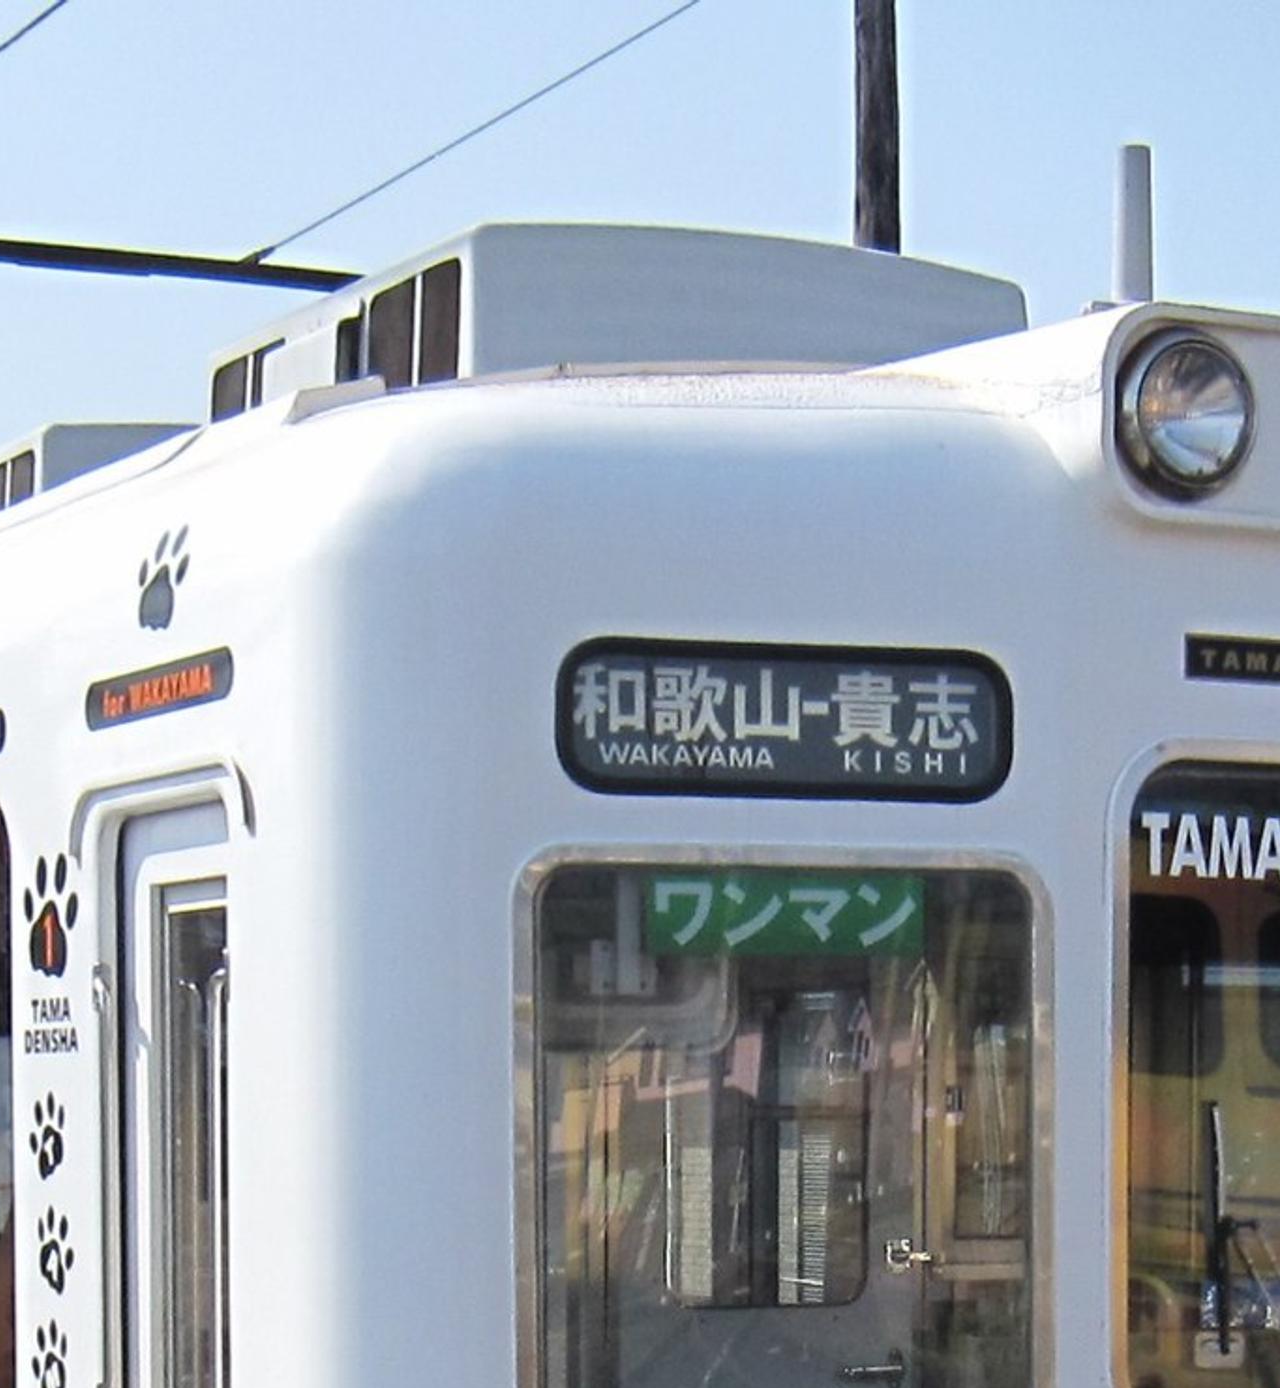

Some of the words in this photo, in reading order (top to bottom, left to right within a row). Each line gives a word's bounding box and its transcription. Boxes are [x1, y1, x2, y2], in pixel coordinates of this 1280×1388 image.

[103, 689, 125, 718] for
[128, 664, 211, 712] WAKAYAMA
[600, 743, 775, 770] WAKAYAMA
[844, 751, 967, 775] KISHI
[654, 880, 917, 948] ワンマン
[31, 998, 71, 1021] TAMA
[24, 1027, 79, 1053] DENSHA
